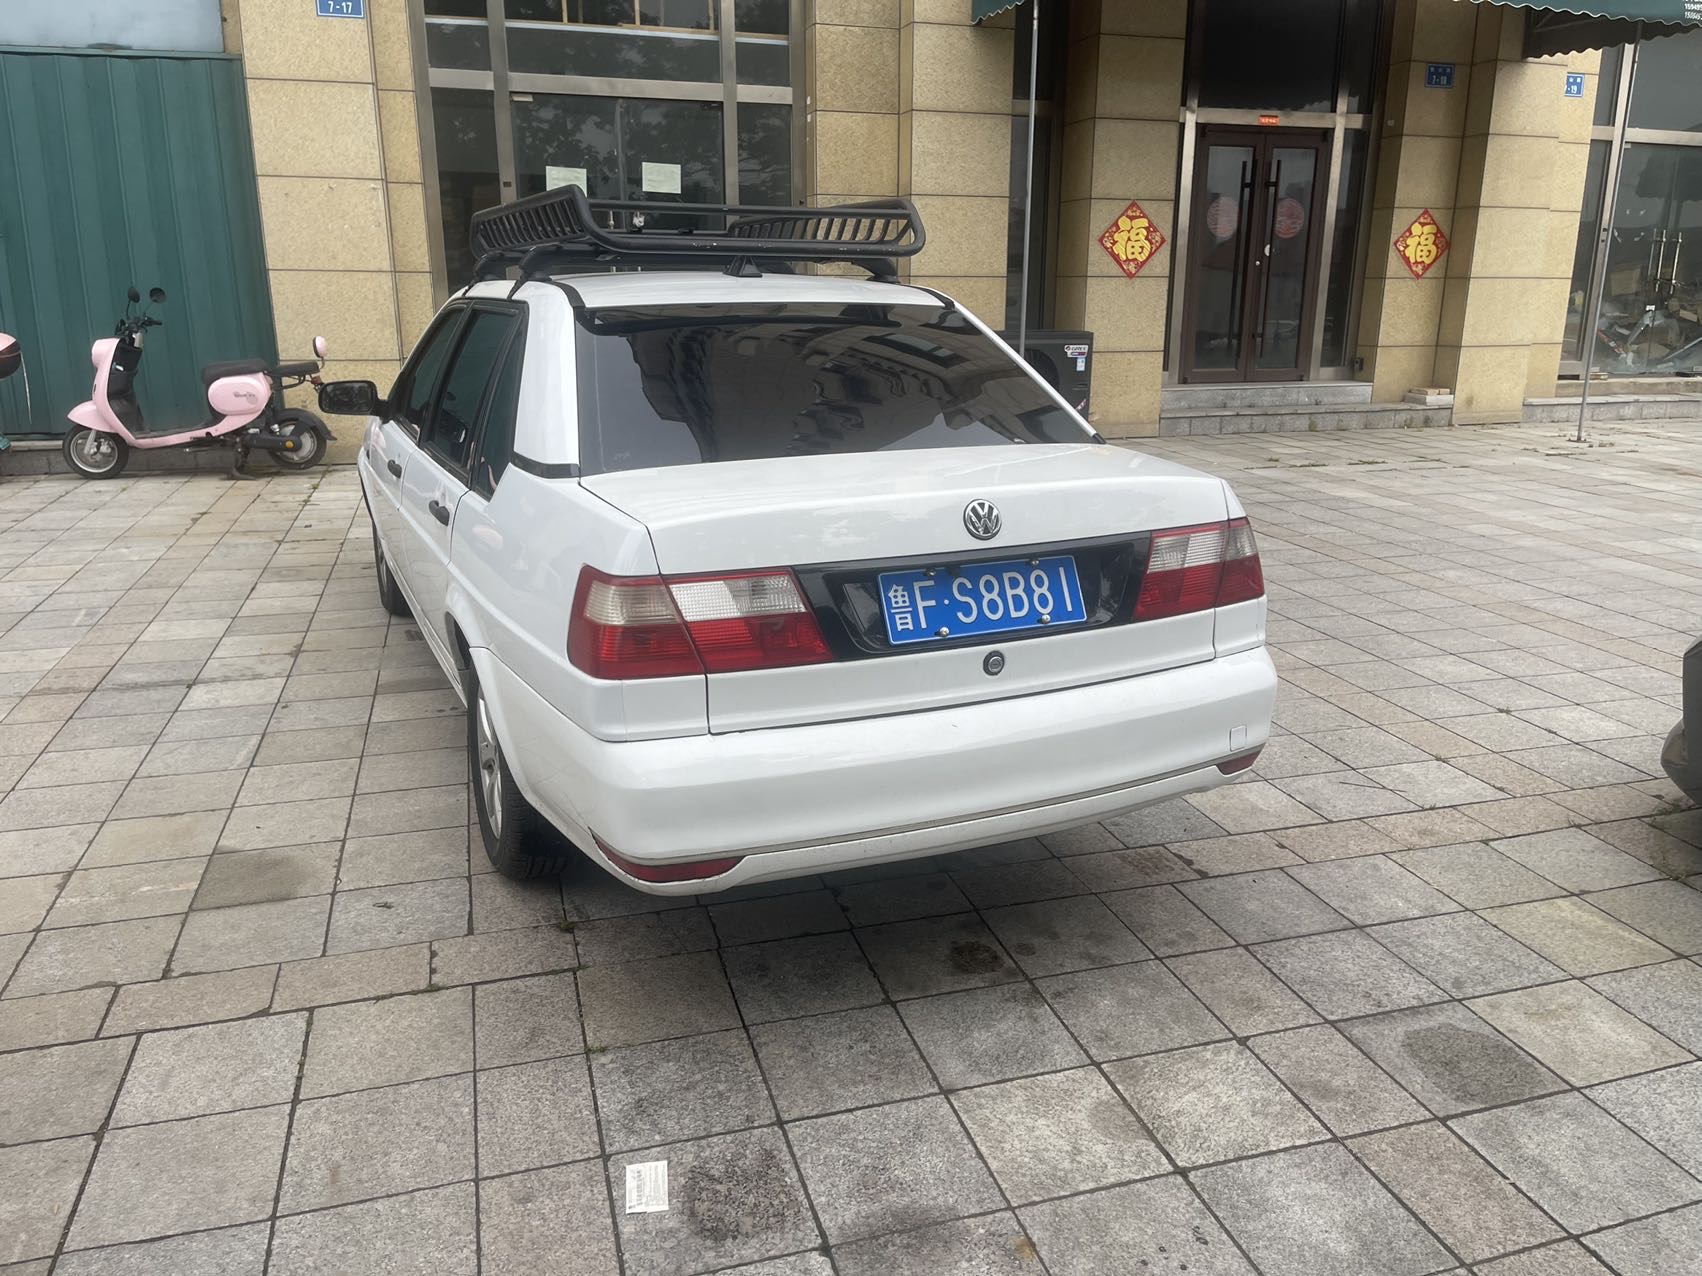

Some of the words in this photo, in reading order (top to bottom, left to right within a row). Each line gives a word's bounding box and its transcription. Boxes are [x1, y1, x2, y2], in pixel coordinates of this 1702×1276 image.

[328, 1, 352, 13] 7-17
[1113, 216, 1151, 262] 福
[1405, 222, 1437, 264] 福
